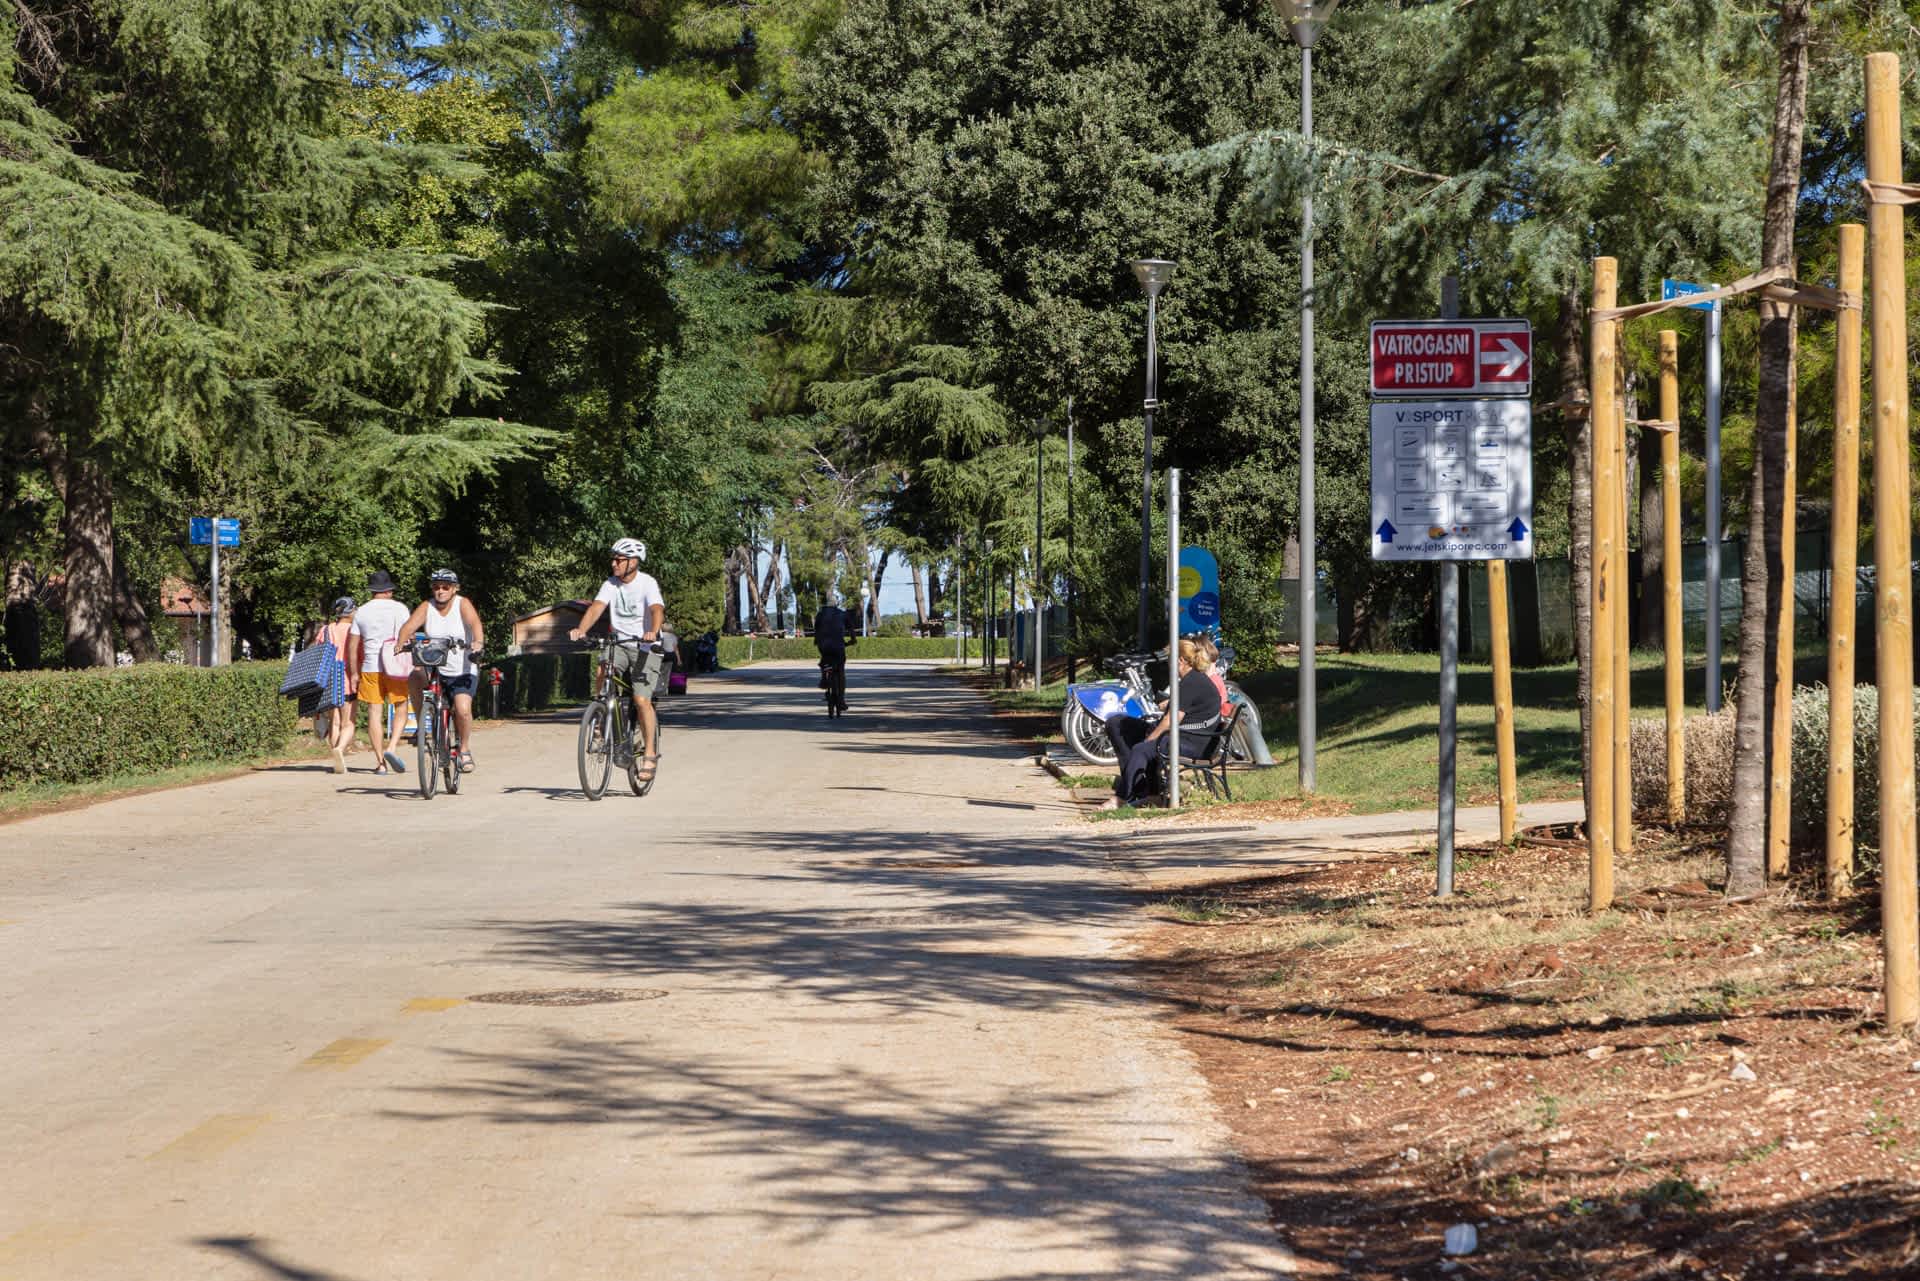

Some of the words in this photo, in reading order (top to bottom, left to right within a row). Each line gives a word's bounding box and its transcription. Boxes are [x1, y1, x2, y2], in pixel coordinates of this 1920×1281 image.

[1377, 333, 1470, 355] VATROGASNI
[1394, 362, 1455, 384] PRISTUP
[1413, 409, 1464, 423] SPORT
